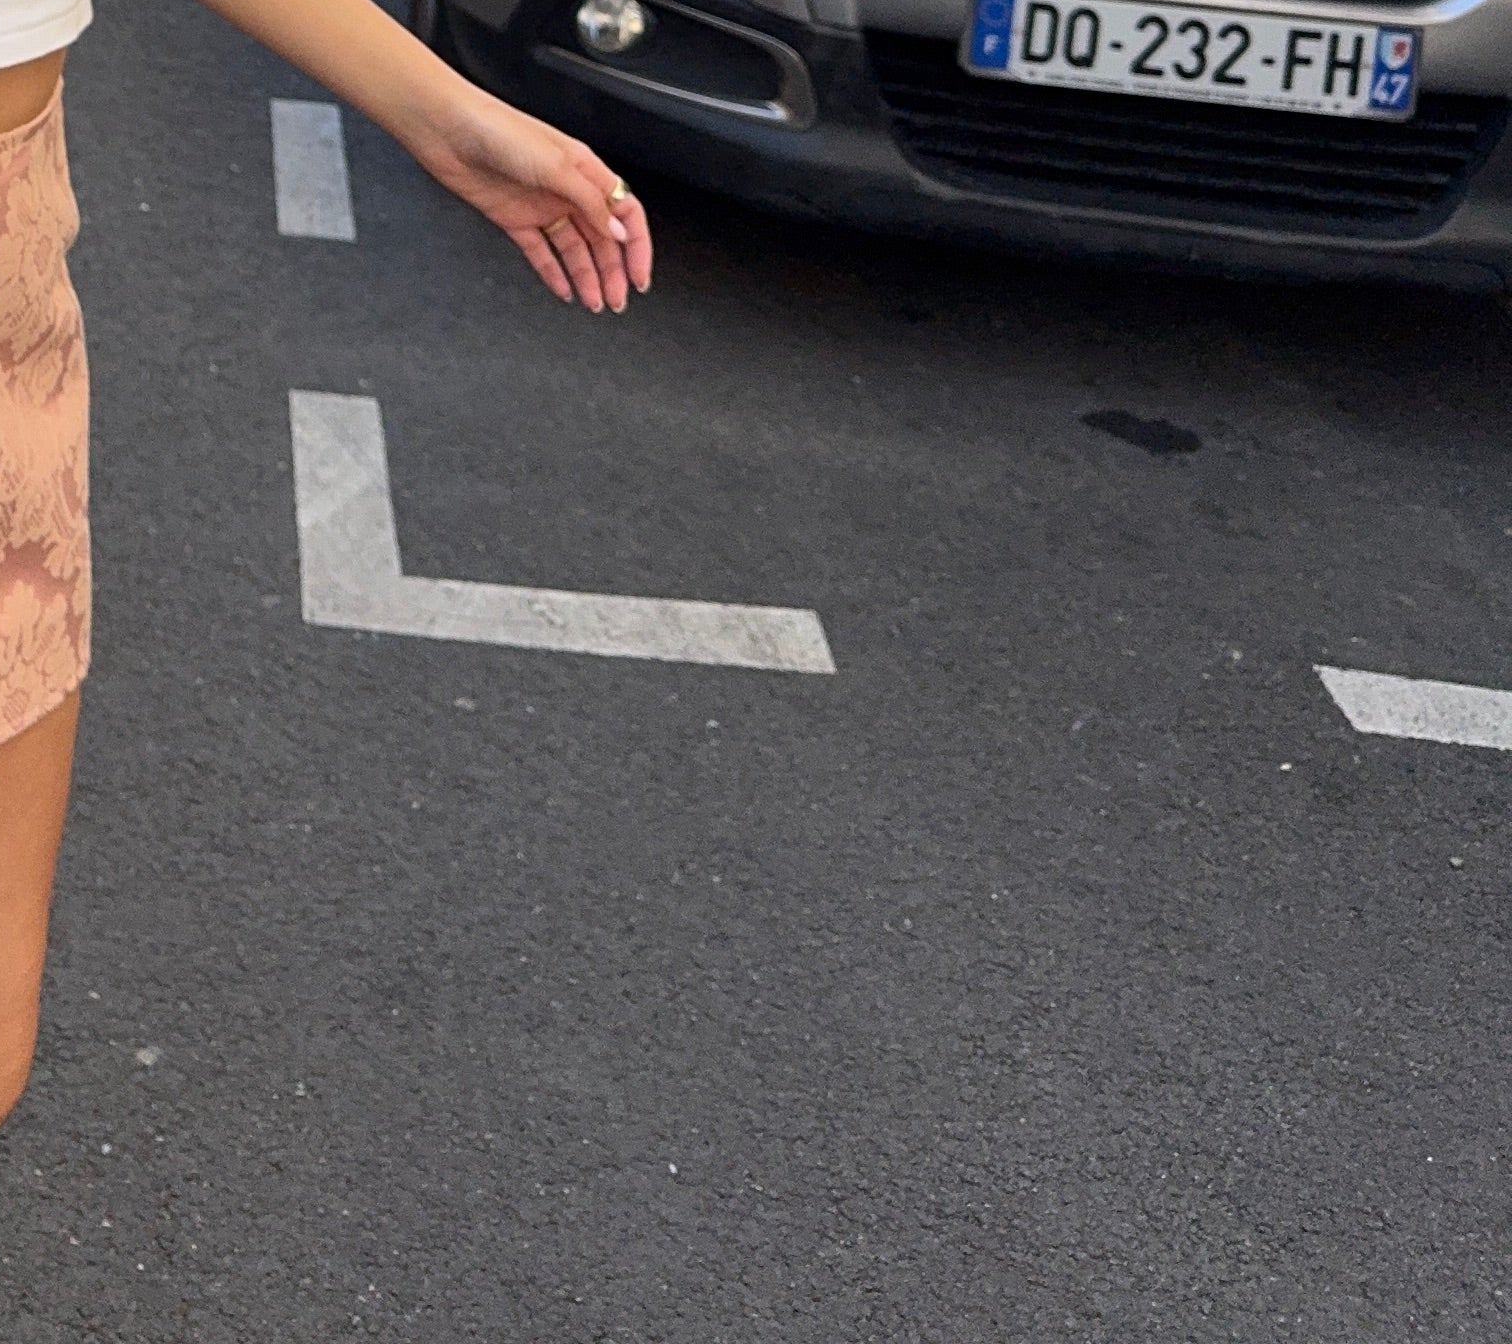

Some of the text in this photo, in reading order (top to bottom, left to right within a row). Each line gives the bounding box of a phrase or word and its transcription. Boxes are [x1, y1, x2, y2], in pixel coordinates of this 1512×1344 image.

[983, 34, 999, 55] F
[1020, 2, 1365, 97] DQ-232-FH
[1373, 72, 1408, 104] 47
